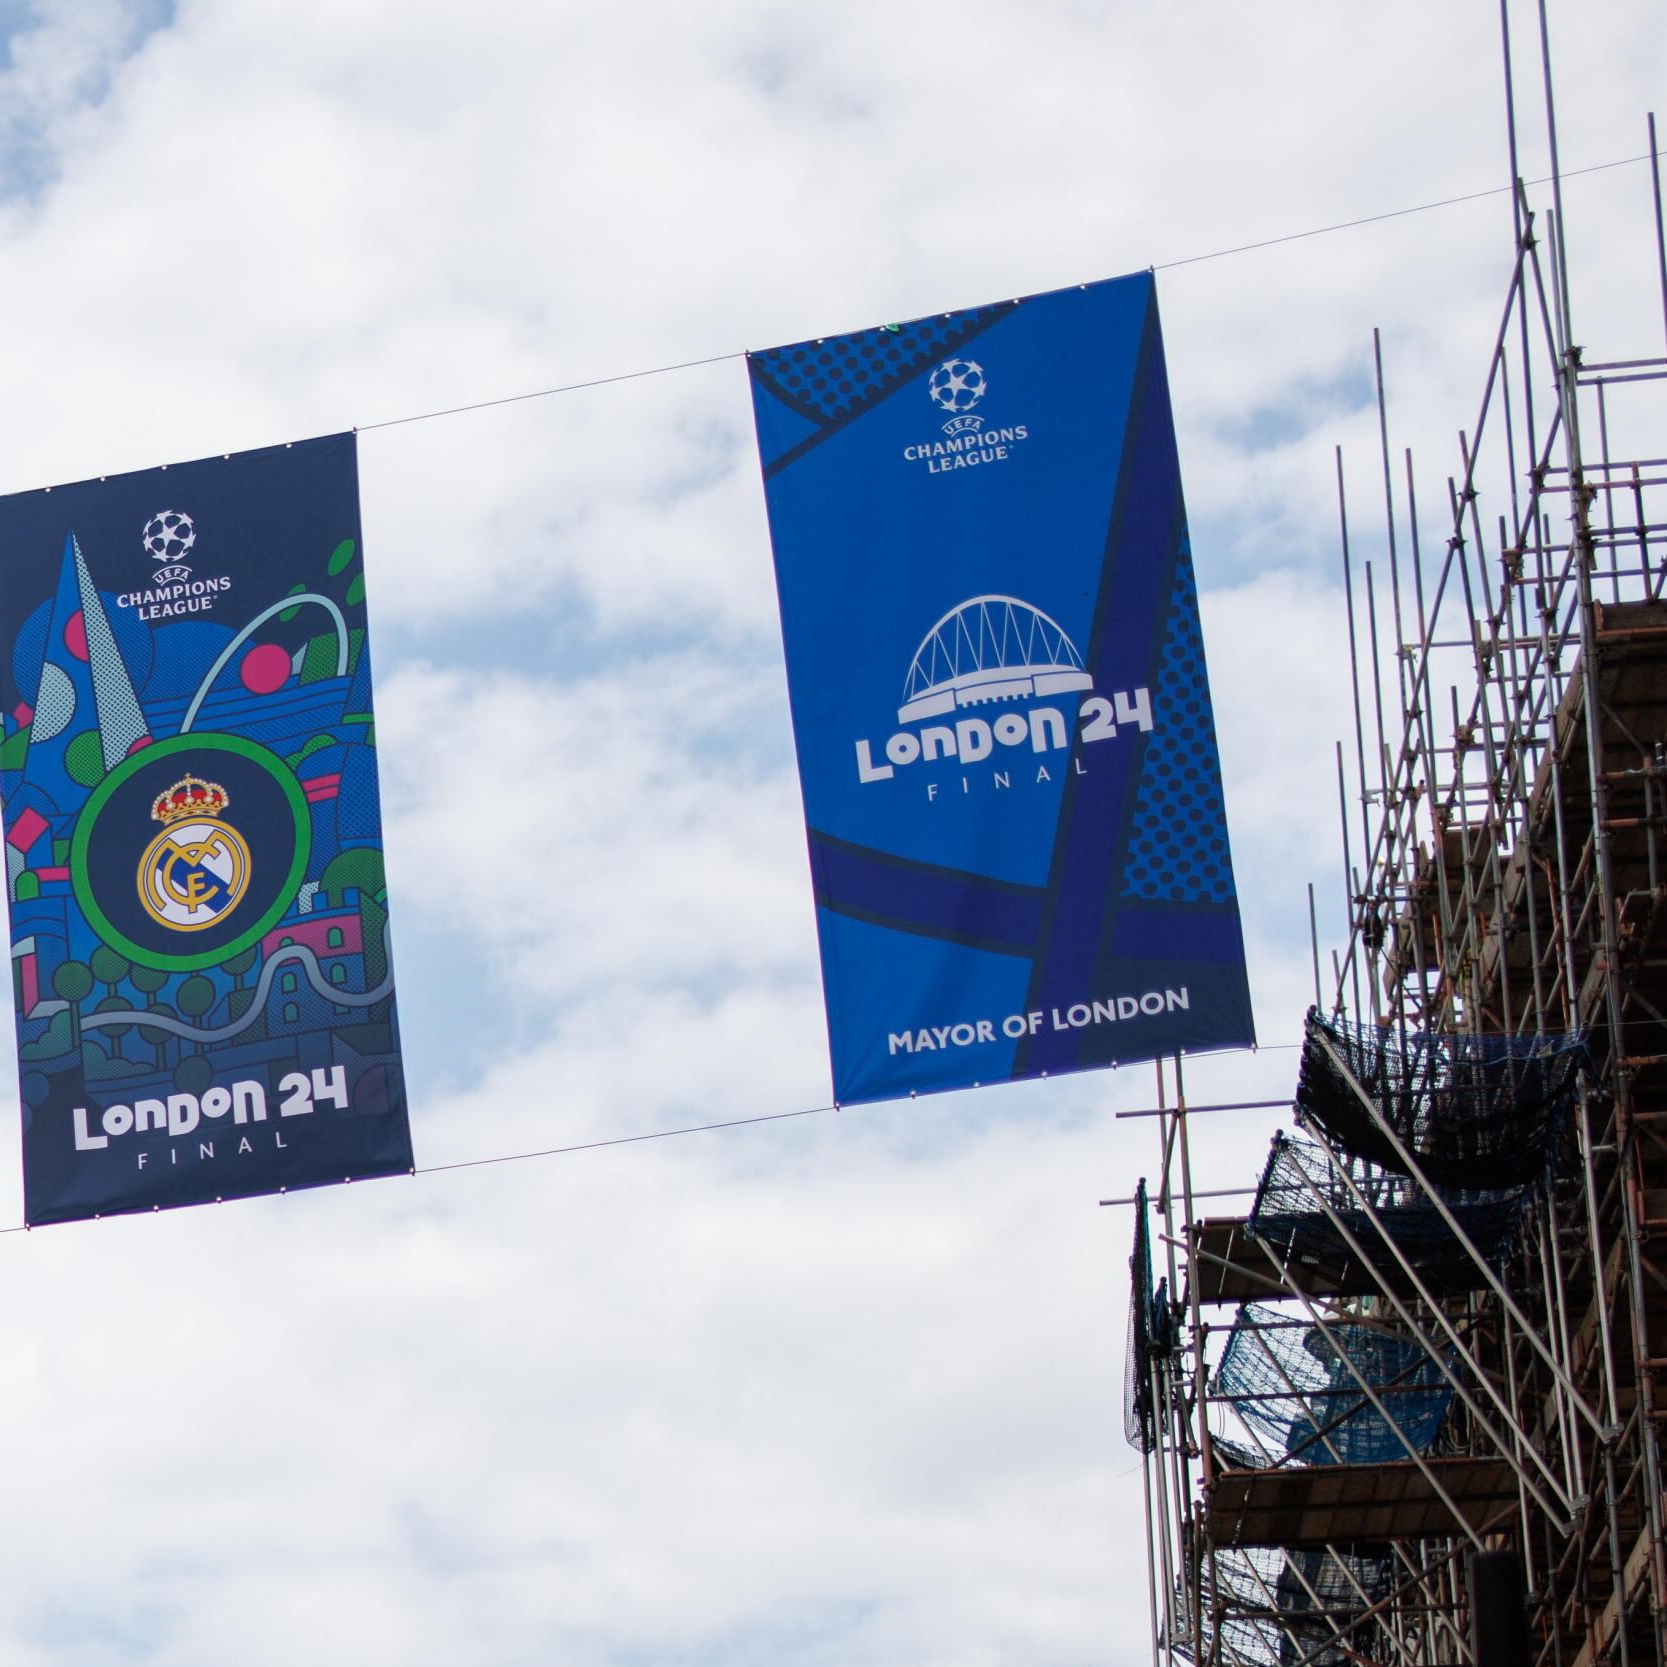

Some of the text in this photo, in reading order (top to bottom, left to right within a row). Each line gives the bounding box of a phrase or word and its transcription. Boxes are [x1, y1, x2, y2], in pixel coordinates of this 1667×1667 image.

[903, 425, 1028, 462] CHAMPIONS
[942, 416, 984, 435] UEFA
[927, 446, 1009, 474] LEAGUE
[117, 577, 231, 609] CHAMPIONS
[153, 566, 192, 584] UEFA
[138, 597, 212, 621] LEAGUE
[1080, 688, 1154, 745] 24
[927, 759, 1088, 802] FINAL
[888, 987, 1191, 1057] MAYOR OF LONDON
[279, 1066, 348, 1118] 24
[138, 1131, 288, 1171] FINAL
